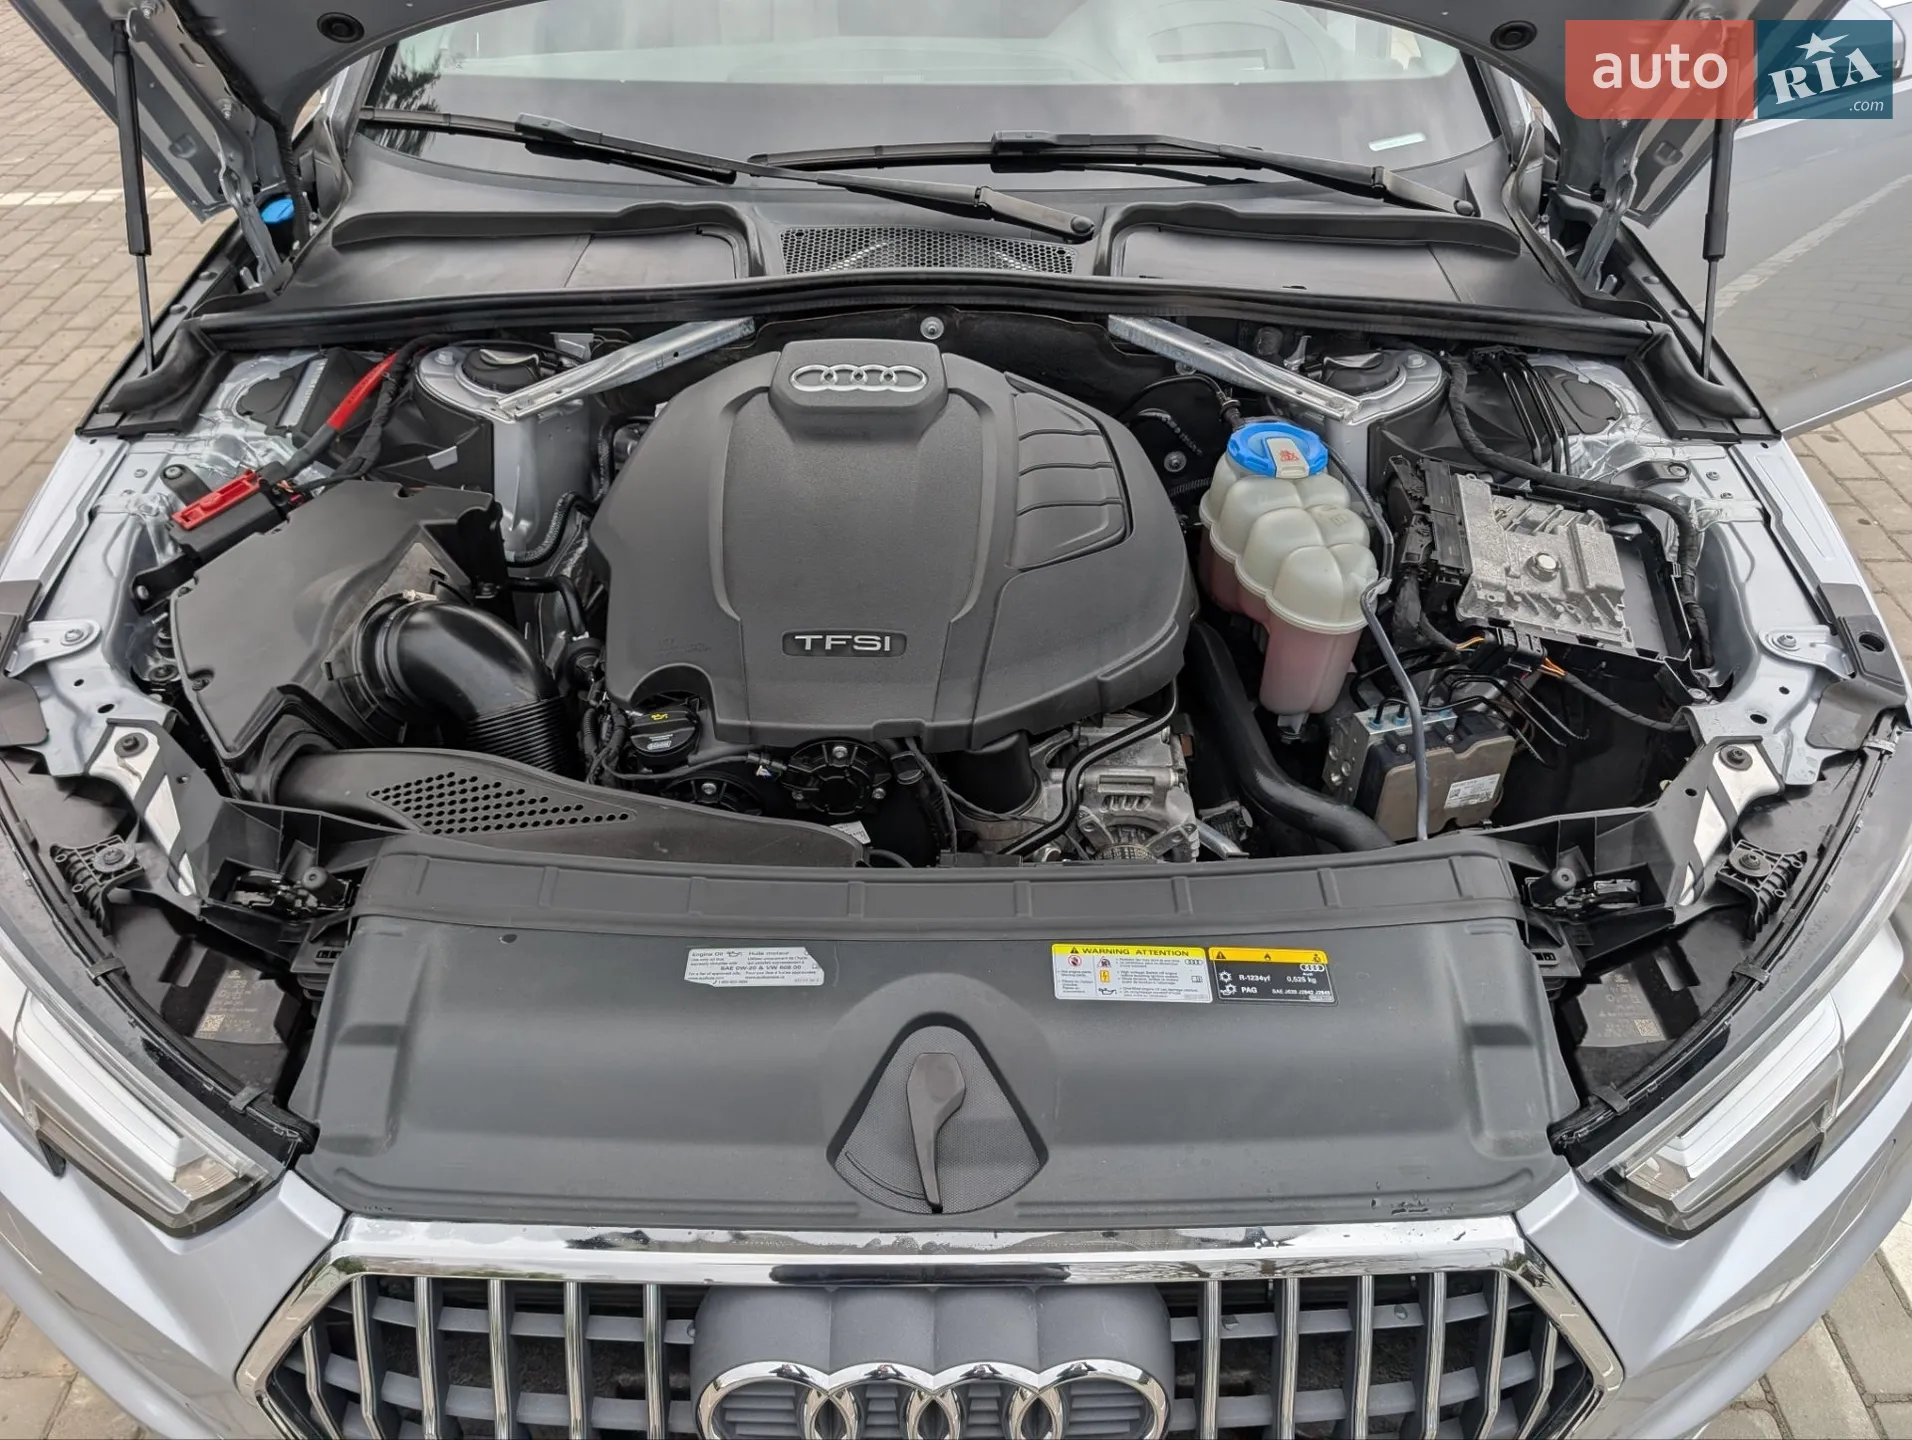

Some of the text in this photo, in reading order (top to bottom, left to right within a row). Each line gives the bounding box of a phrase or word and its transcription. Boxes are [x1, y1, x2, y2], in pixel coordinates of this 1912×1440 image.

[794, 635, 891, 652] TFSI
[1082, 947, 1189, 957] WARNING ATTENTION
[1238, 974, 1271, 983] R-1234yf
[1307, 976, 1317, 984] kg
[1241, 986, 1258, 994] PAG
